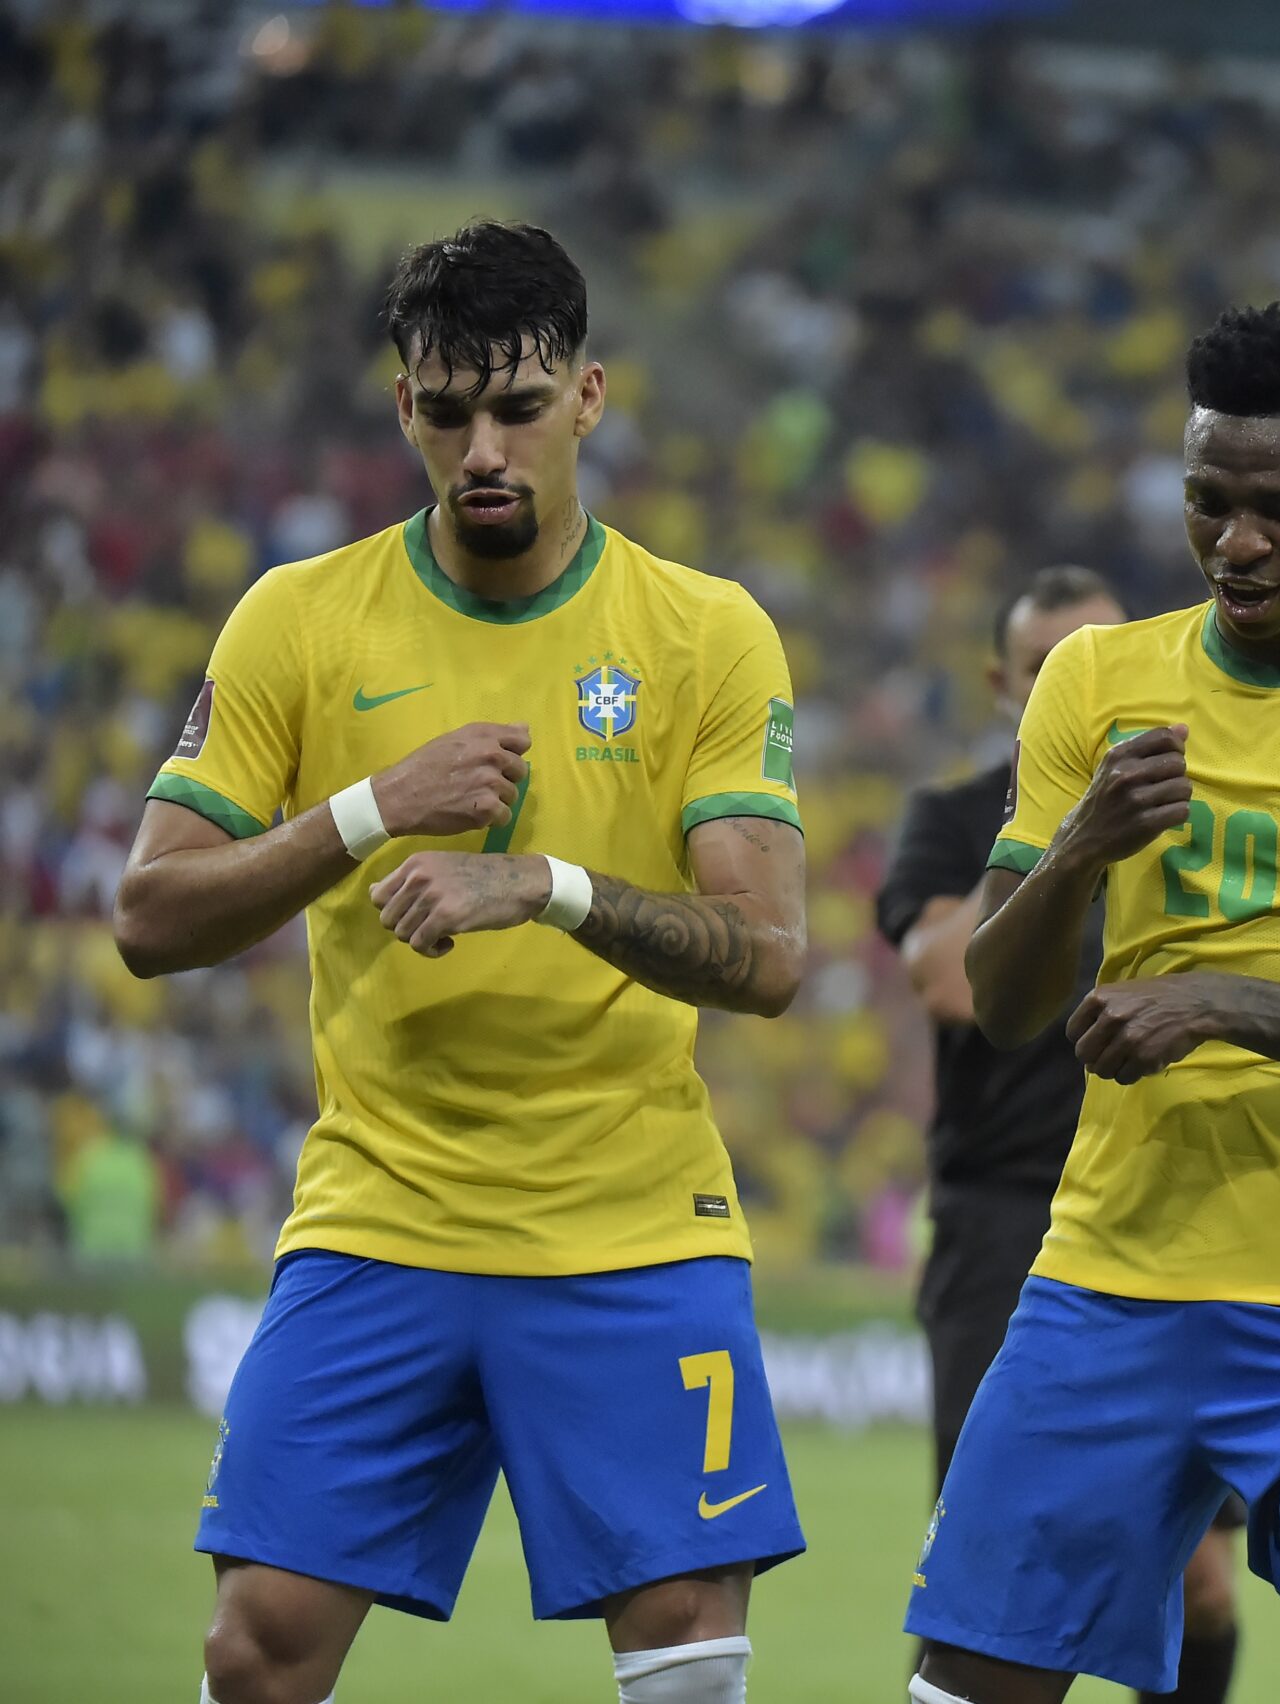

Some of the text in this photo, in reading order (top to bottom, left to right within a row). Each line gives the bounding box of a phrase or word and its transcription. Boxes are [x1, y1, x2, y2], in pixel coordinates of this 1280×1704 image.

[595, 696, 619, 705] CBF
[576, 747, 640, 762] BRASIL
[1160, 799, 1279, 922] 20
[678, 1350, 735, 1474] 7
